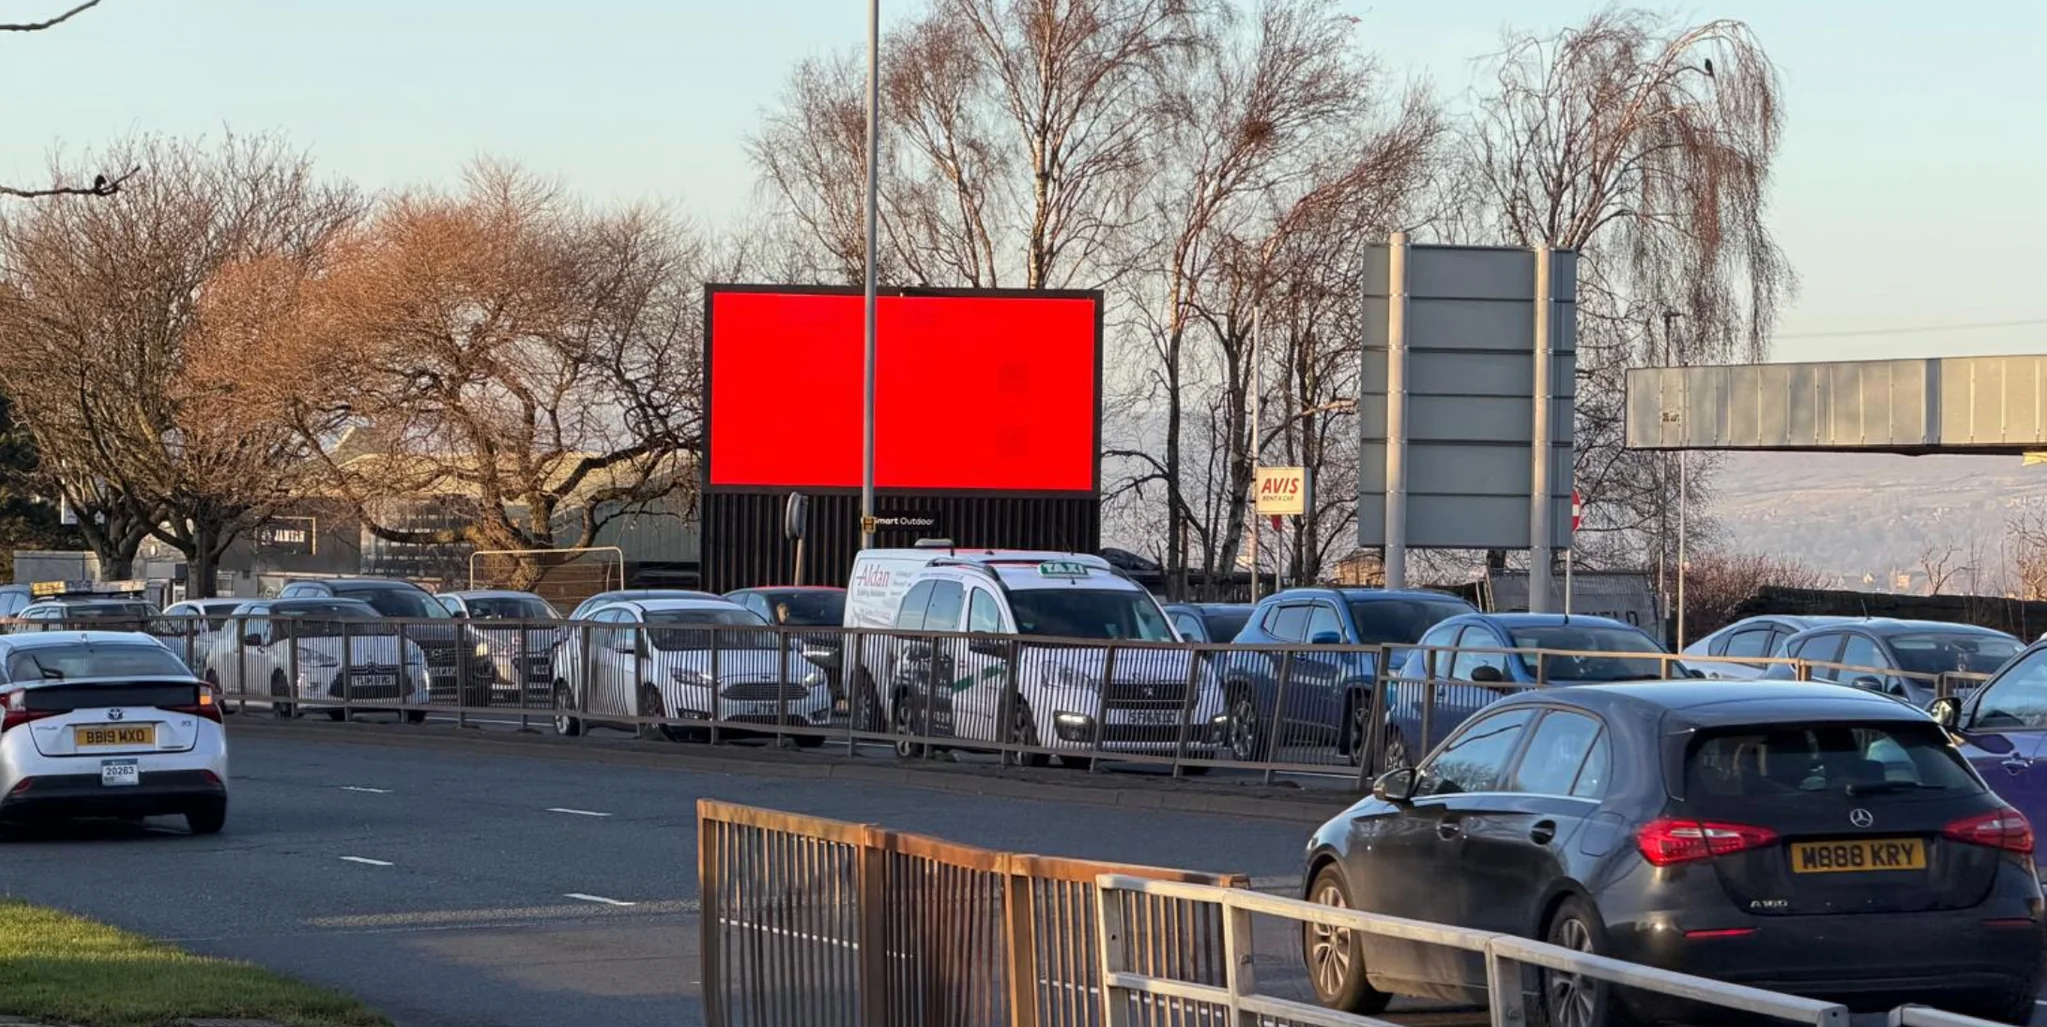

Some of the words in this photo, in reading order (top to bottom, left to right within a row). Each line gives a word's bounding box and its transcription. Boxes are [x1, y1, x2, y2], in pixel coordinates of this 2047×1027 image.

[1261, 477, 1299, 494] AVIS
[900, 516, 935, 526] Outdoor
[1044, 562, 1085, 574] TAXI
[856, 563, 890, 588] Aldan
[86, 730, 116, 744] BB19
[105, 766, 134, 776] 20263
[1802, 845, 1865, 869] M888
[1870, 843, 1914, 867] KRY
